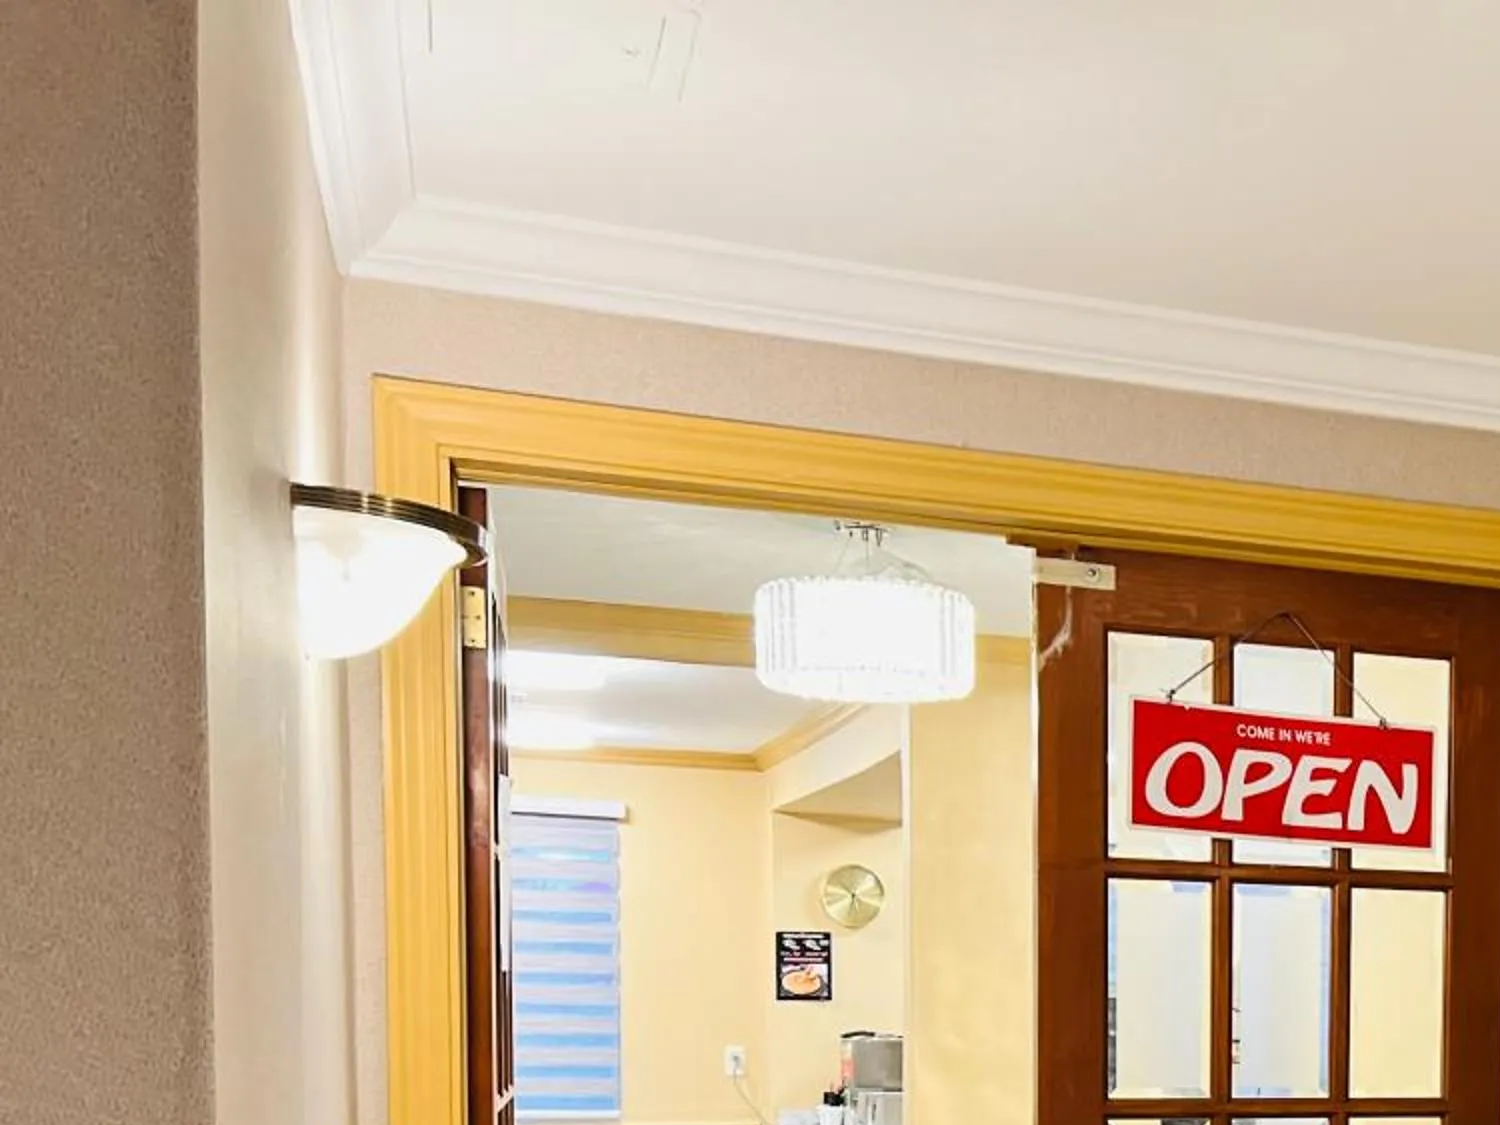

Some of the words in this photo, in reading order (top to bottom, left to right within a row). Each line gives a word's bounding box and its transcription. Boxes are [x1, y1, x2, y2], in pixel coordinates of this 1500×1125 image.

[1236, 723, 1275, 741] COME
[1278, 728, 1292, 742] IN
[1294, 729, 1331, 746] WE'RE
[1145, 741, 1419, 834] OPEN
